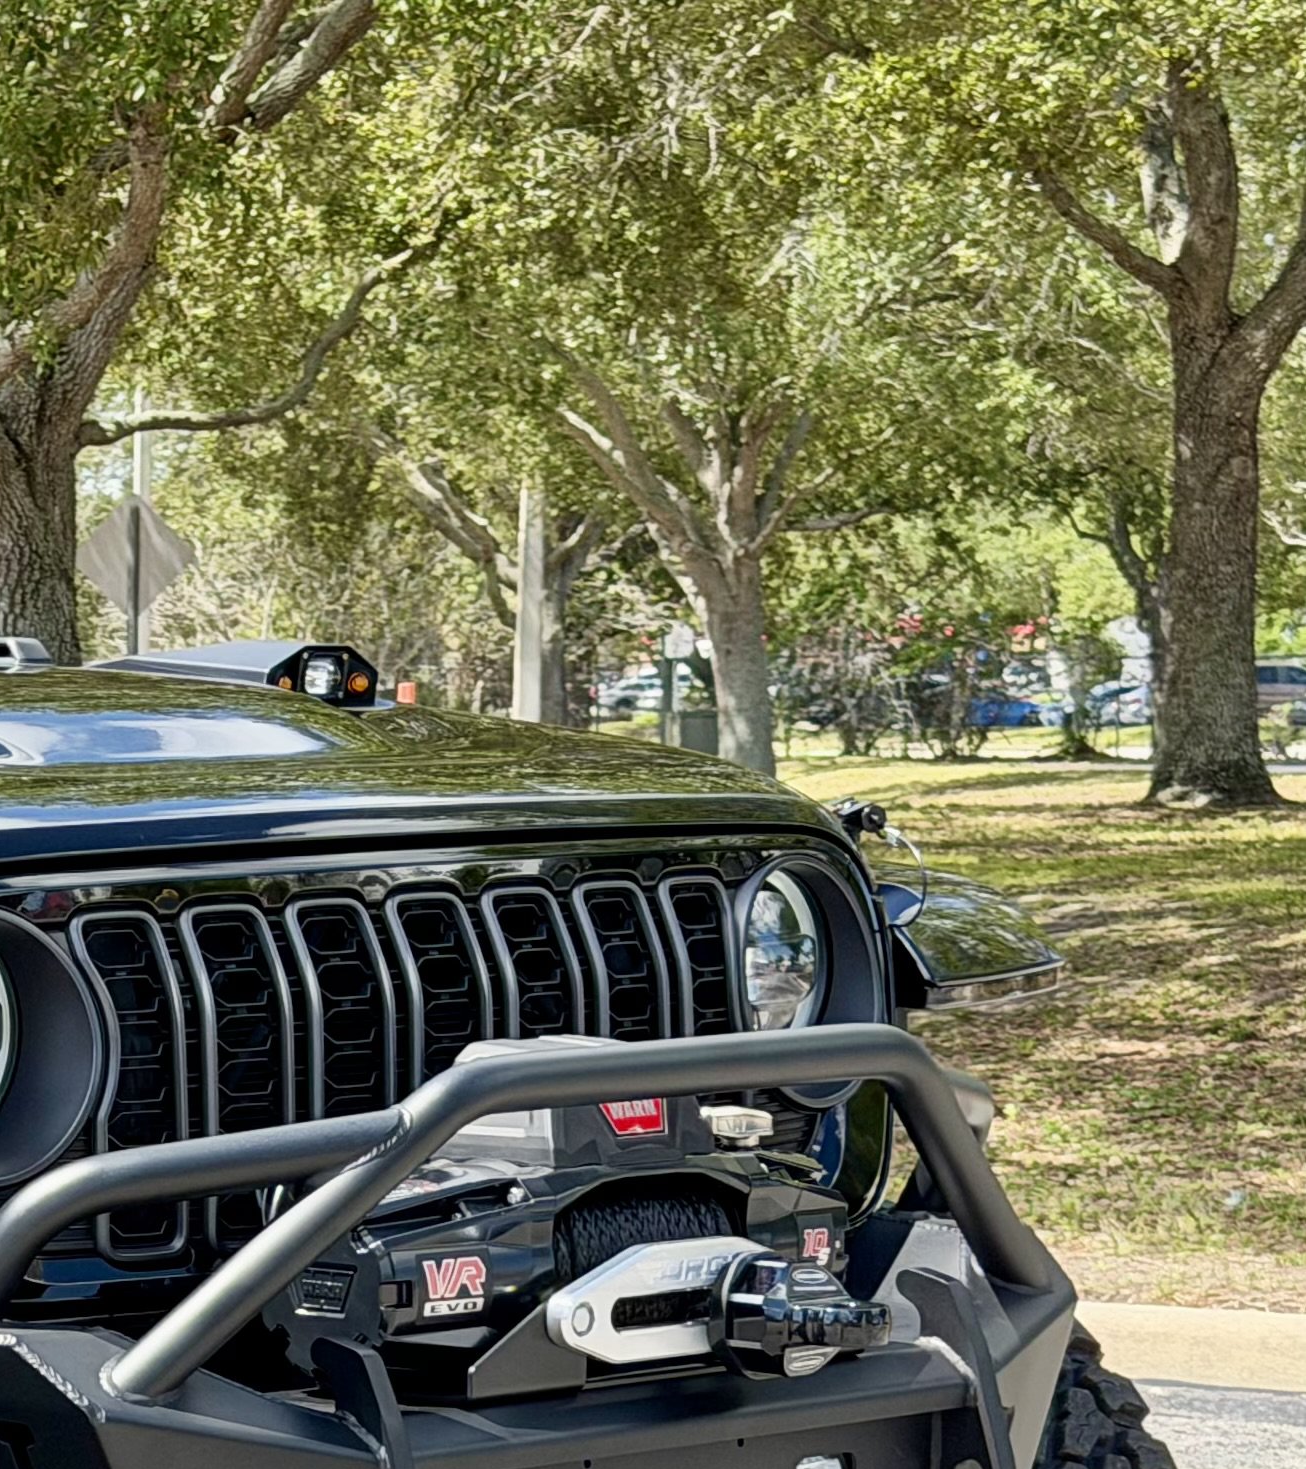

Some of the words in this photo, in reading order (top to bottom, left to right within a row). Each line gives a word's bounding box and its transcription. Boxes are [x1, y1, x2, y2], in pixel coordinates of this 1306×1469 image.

[606, 1099, 658, 1120] WARN
[421, 1255, 487, 1301] VR
[429, 1301, 479, 1315] EVO
